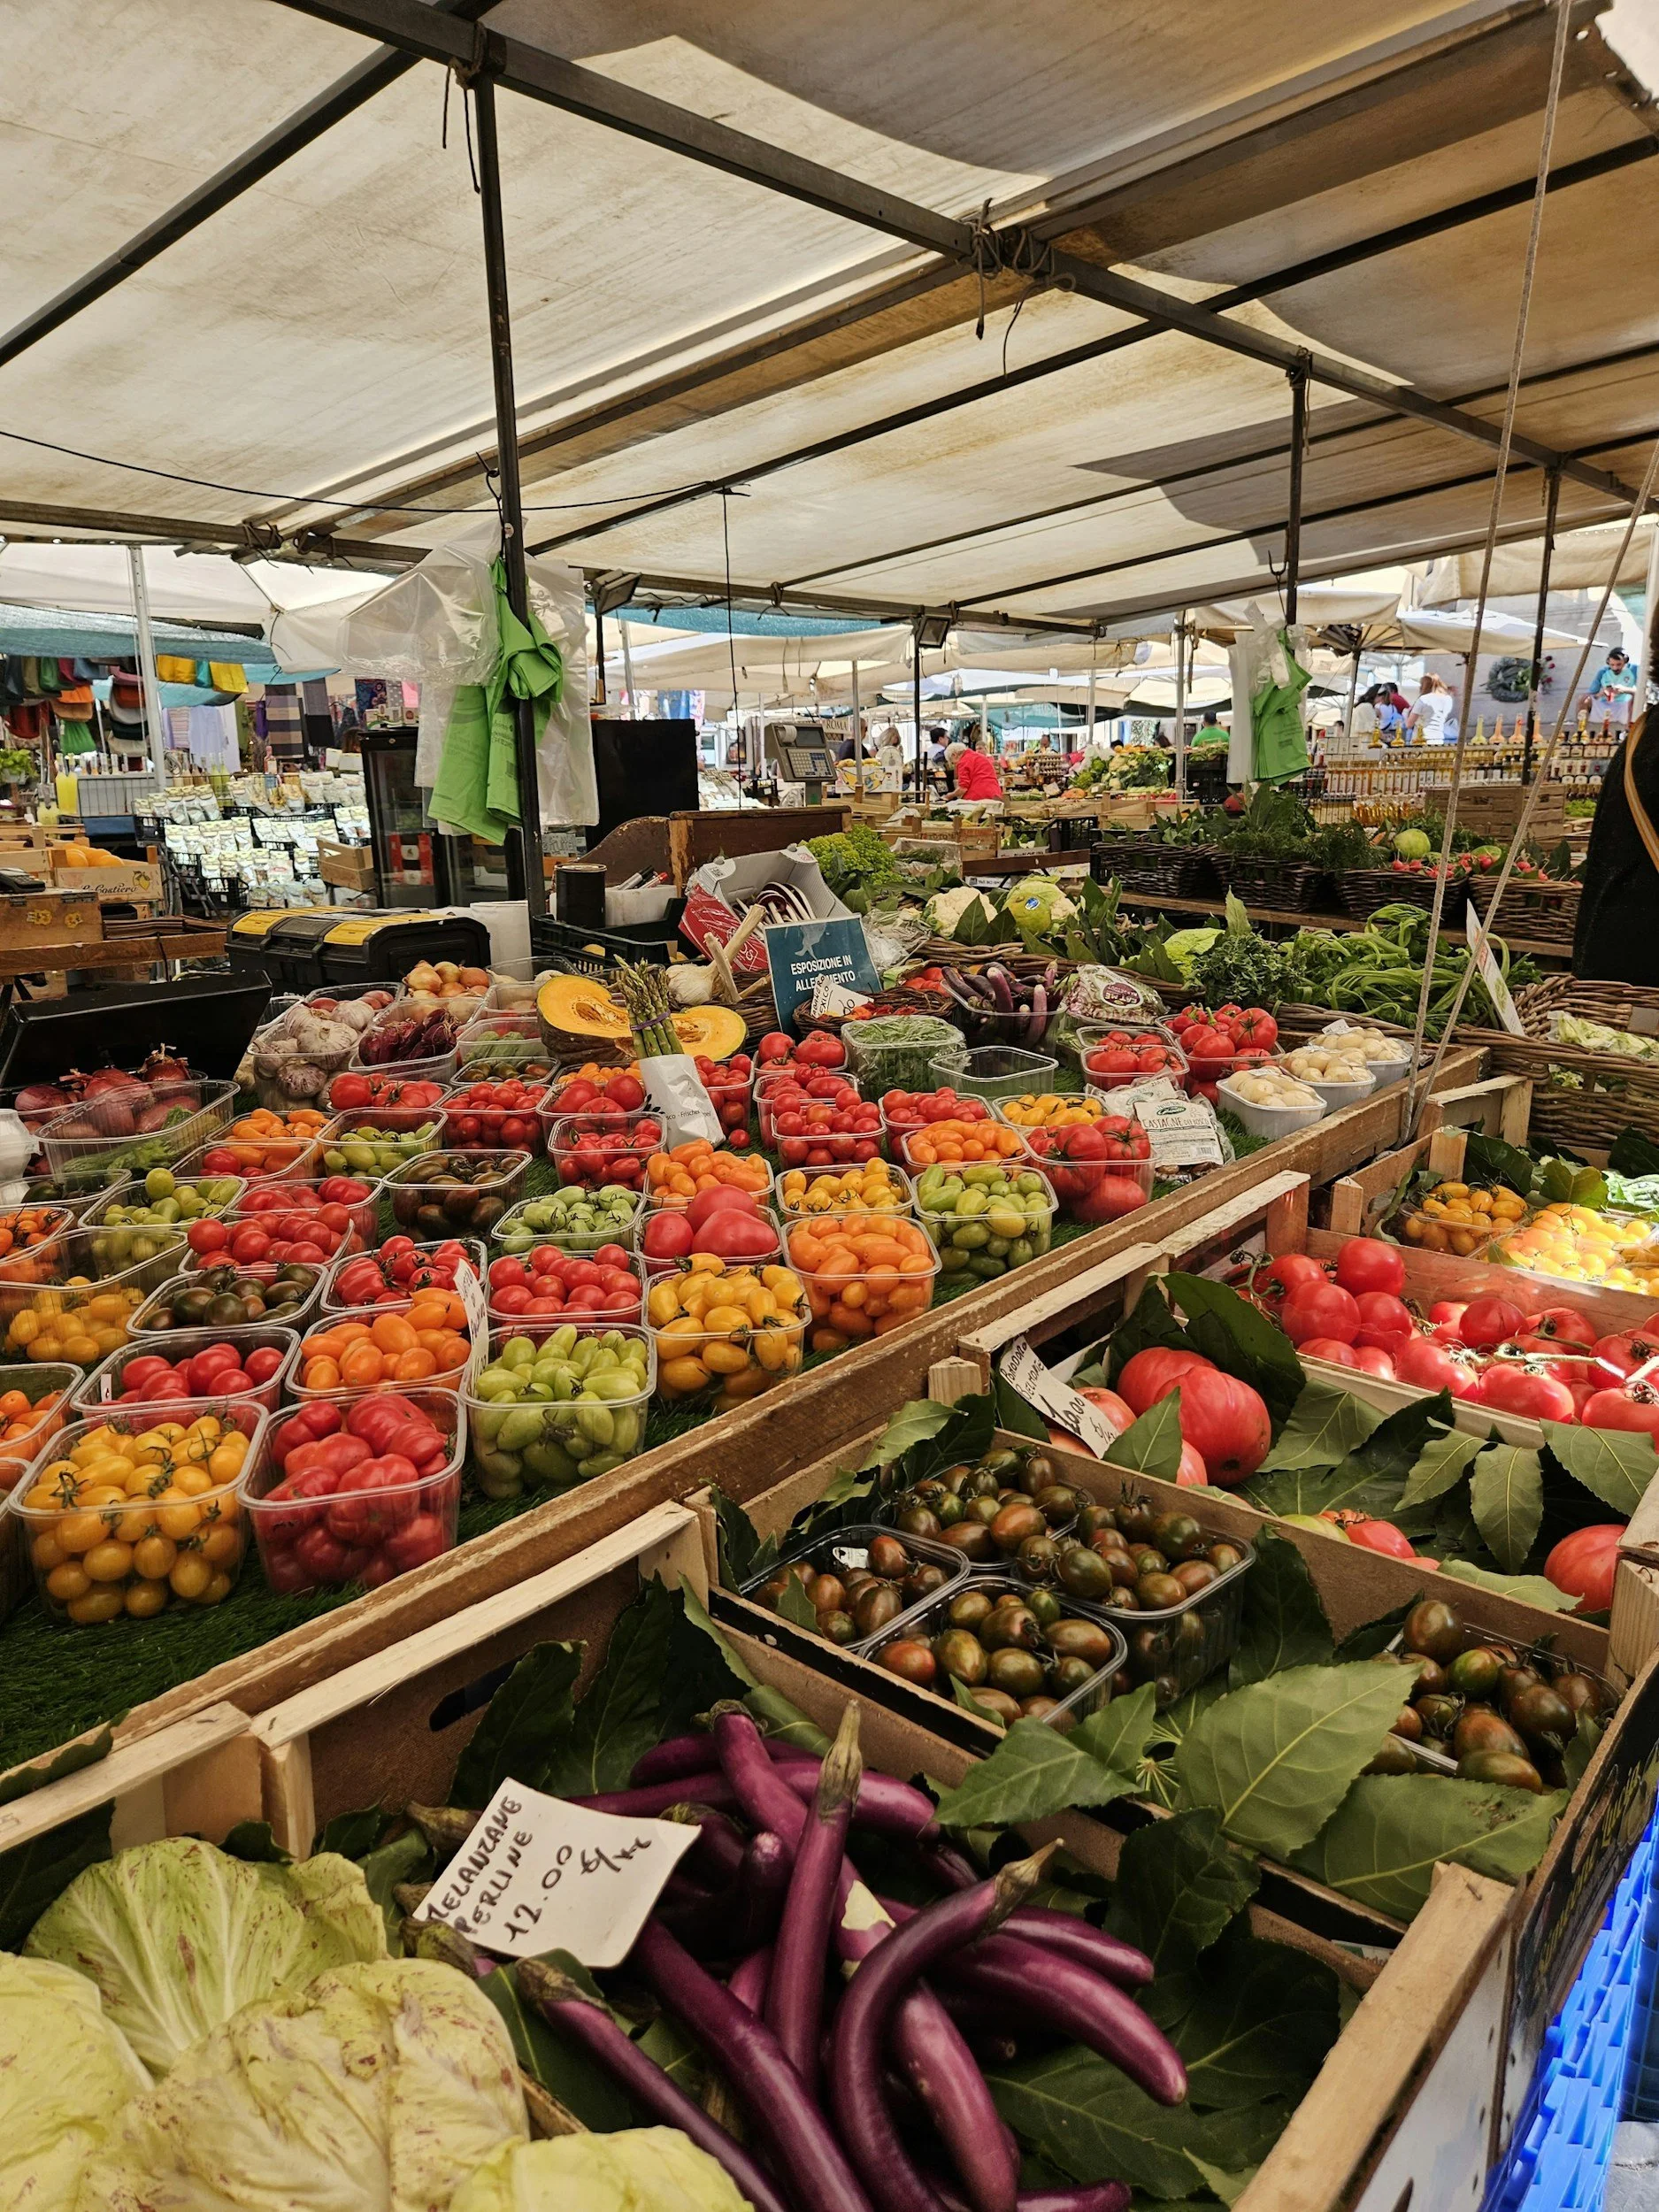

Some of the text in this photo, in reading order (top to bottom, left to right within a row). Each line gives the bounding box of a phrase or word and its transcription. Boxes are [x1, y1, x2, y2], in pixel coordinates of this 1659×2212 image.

[790, 955, 853, 975] ESPOSIZIONE IN
[795, 970, 856, 992] ALLEMENTO
[1142, 1117, 1183, 1129] CASTAGNE
[1000, 1341, 1027, 1385] POMODORO
[425, 1795, 523, 1923] MELANZANE
[454, 1831, 534, 1934] PERLINE
[503, 1845, 573, 1943] 12.00
